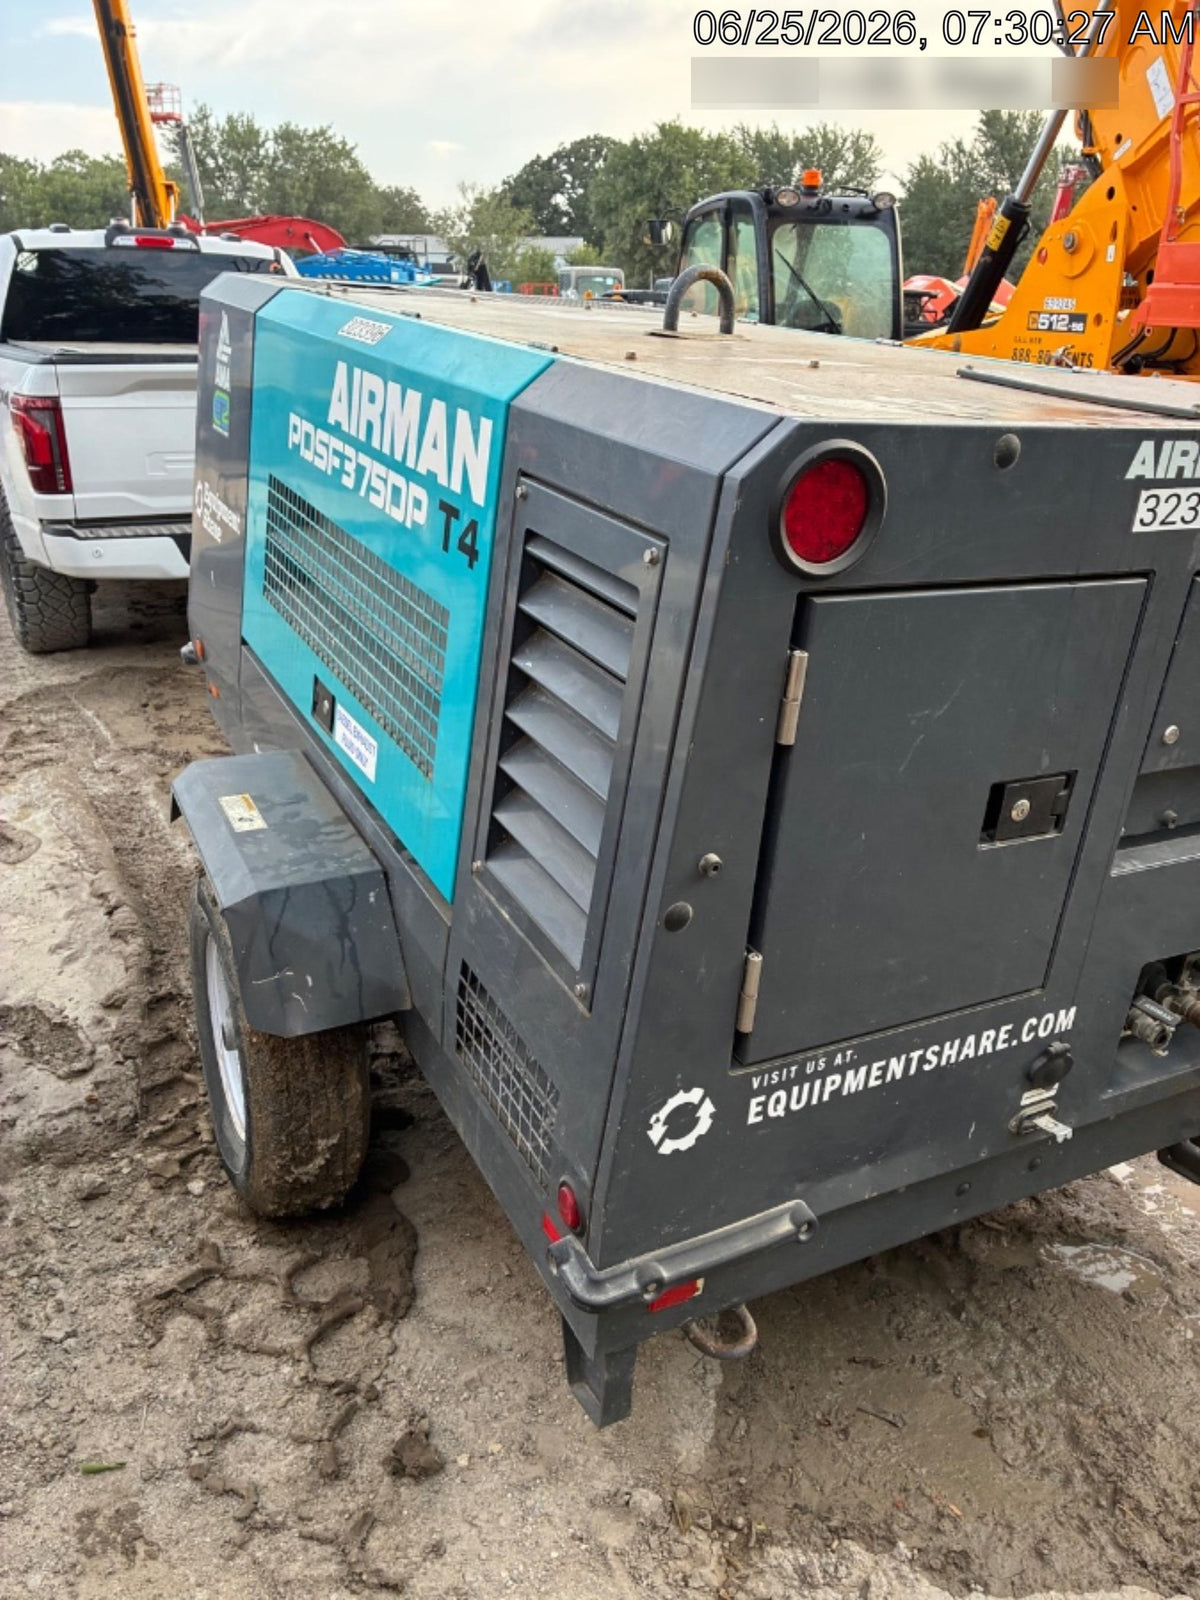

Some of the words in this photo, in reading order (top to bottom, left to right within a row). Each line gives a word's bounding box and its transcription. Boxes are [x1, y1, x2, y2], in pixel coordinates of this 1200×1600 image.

[289, 412, 429, 529] PDSF375DP
[327, 360, 493, 507] AIRMAN
[1124, 440, 1200, 479] AIR
[438, 499, 479, 570] T4
[747, 1006, 1077, 1126] EQUIPMENTSHARE.COM
[752, 1064, 798, 1090] VISIT
[805, 1056, 827, 1075] US
